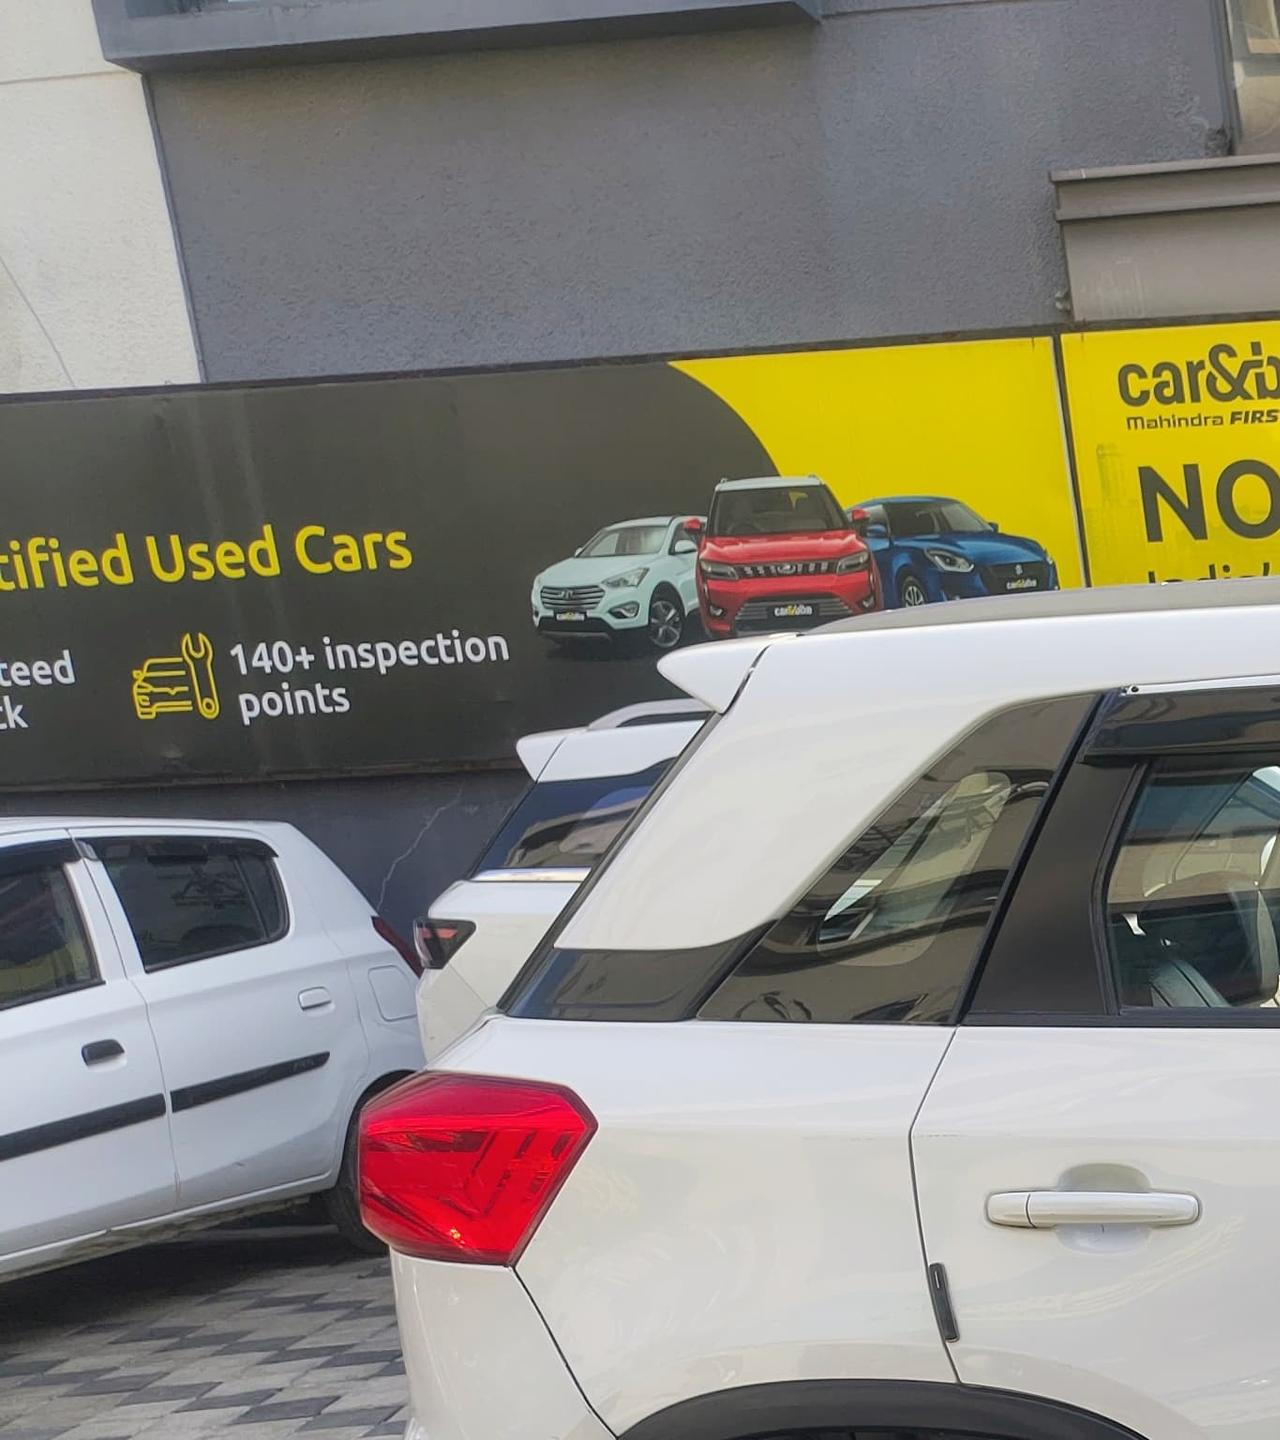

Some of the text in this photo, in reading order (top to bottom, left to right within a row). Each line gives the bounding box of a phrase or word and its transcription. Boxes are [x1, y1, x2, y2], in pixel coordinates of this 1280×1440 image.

[1126, 412, 1224, 431] Mahindra
[145, 523, 280, 582] Used
[294, 525, 413, 573] Cars
[230, 629, 510, 675] 140+ inspection
[239, 681, 350, 726] points
